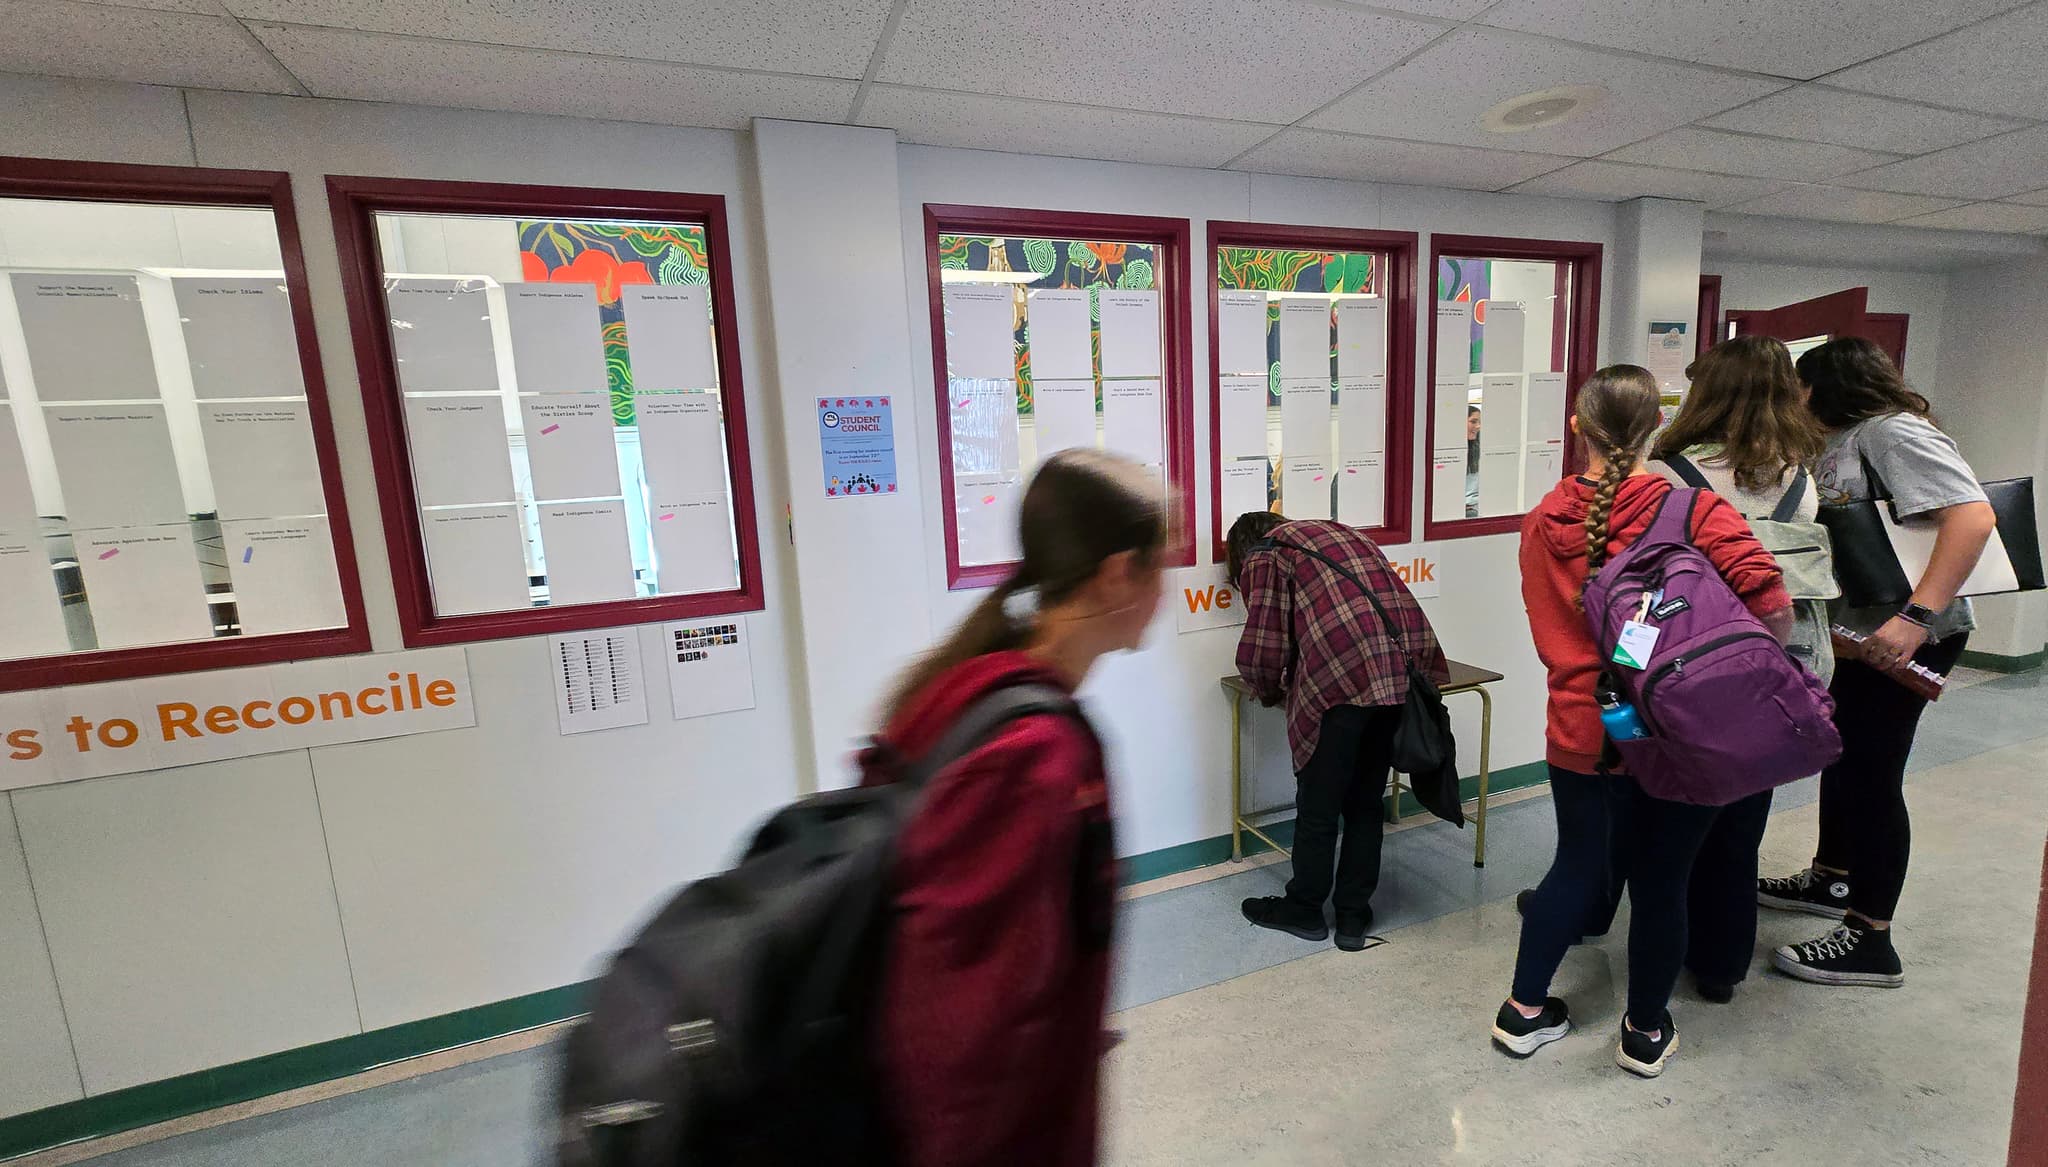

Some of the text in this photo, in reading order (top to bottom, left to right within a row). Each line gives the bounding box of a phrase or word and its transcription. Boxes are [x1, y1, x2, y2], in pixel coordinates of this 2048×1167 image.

[840, 416, 882, 425] STUDENT
[841, 424, 882, 433] COUNCIL
[1184, 584, 1232, 614] We
[0, 672, 458, 760] s to Reconcile
